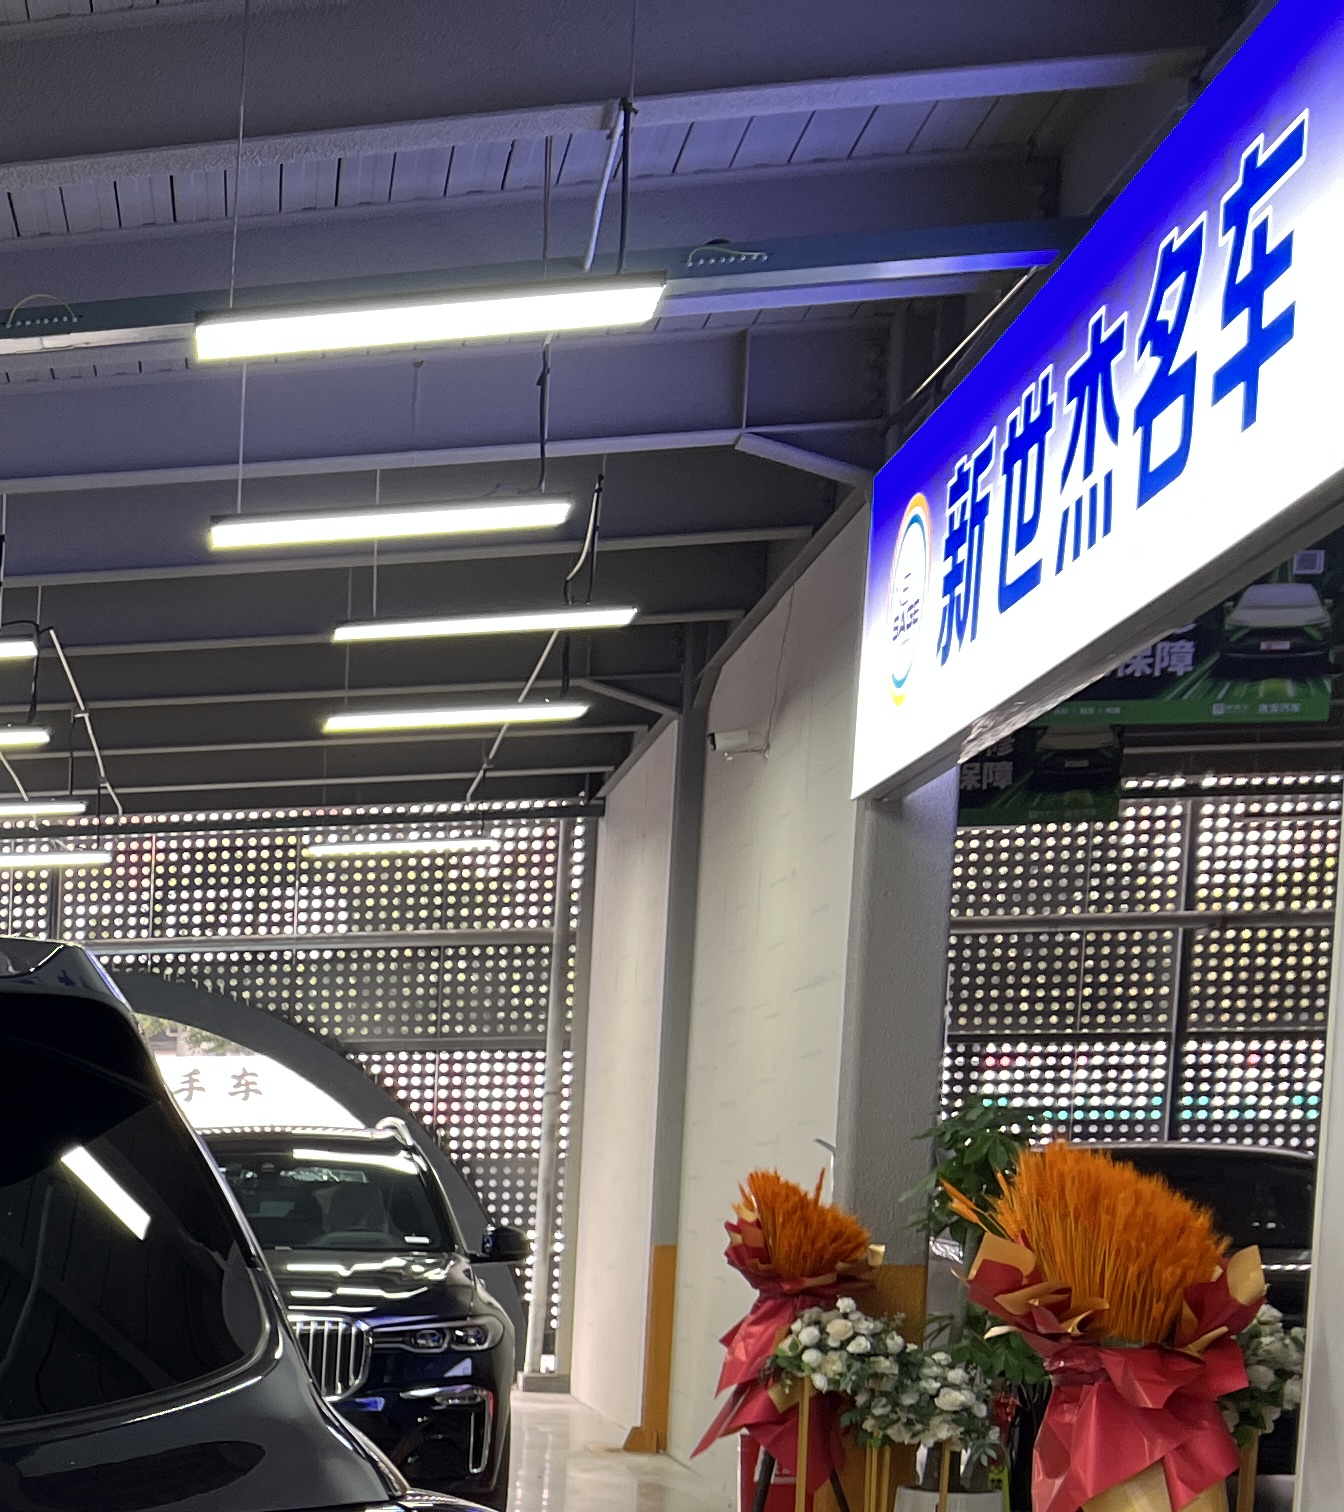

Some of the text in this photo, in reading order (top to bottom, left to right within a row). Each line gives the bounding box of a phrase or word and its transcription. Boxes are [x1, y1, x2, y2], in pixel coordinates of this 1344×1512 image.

[936, 112, 1311, 668] 新世杰名车
